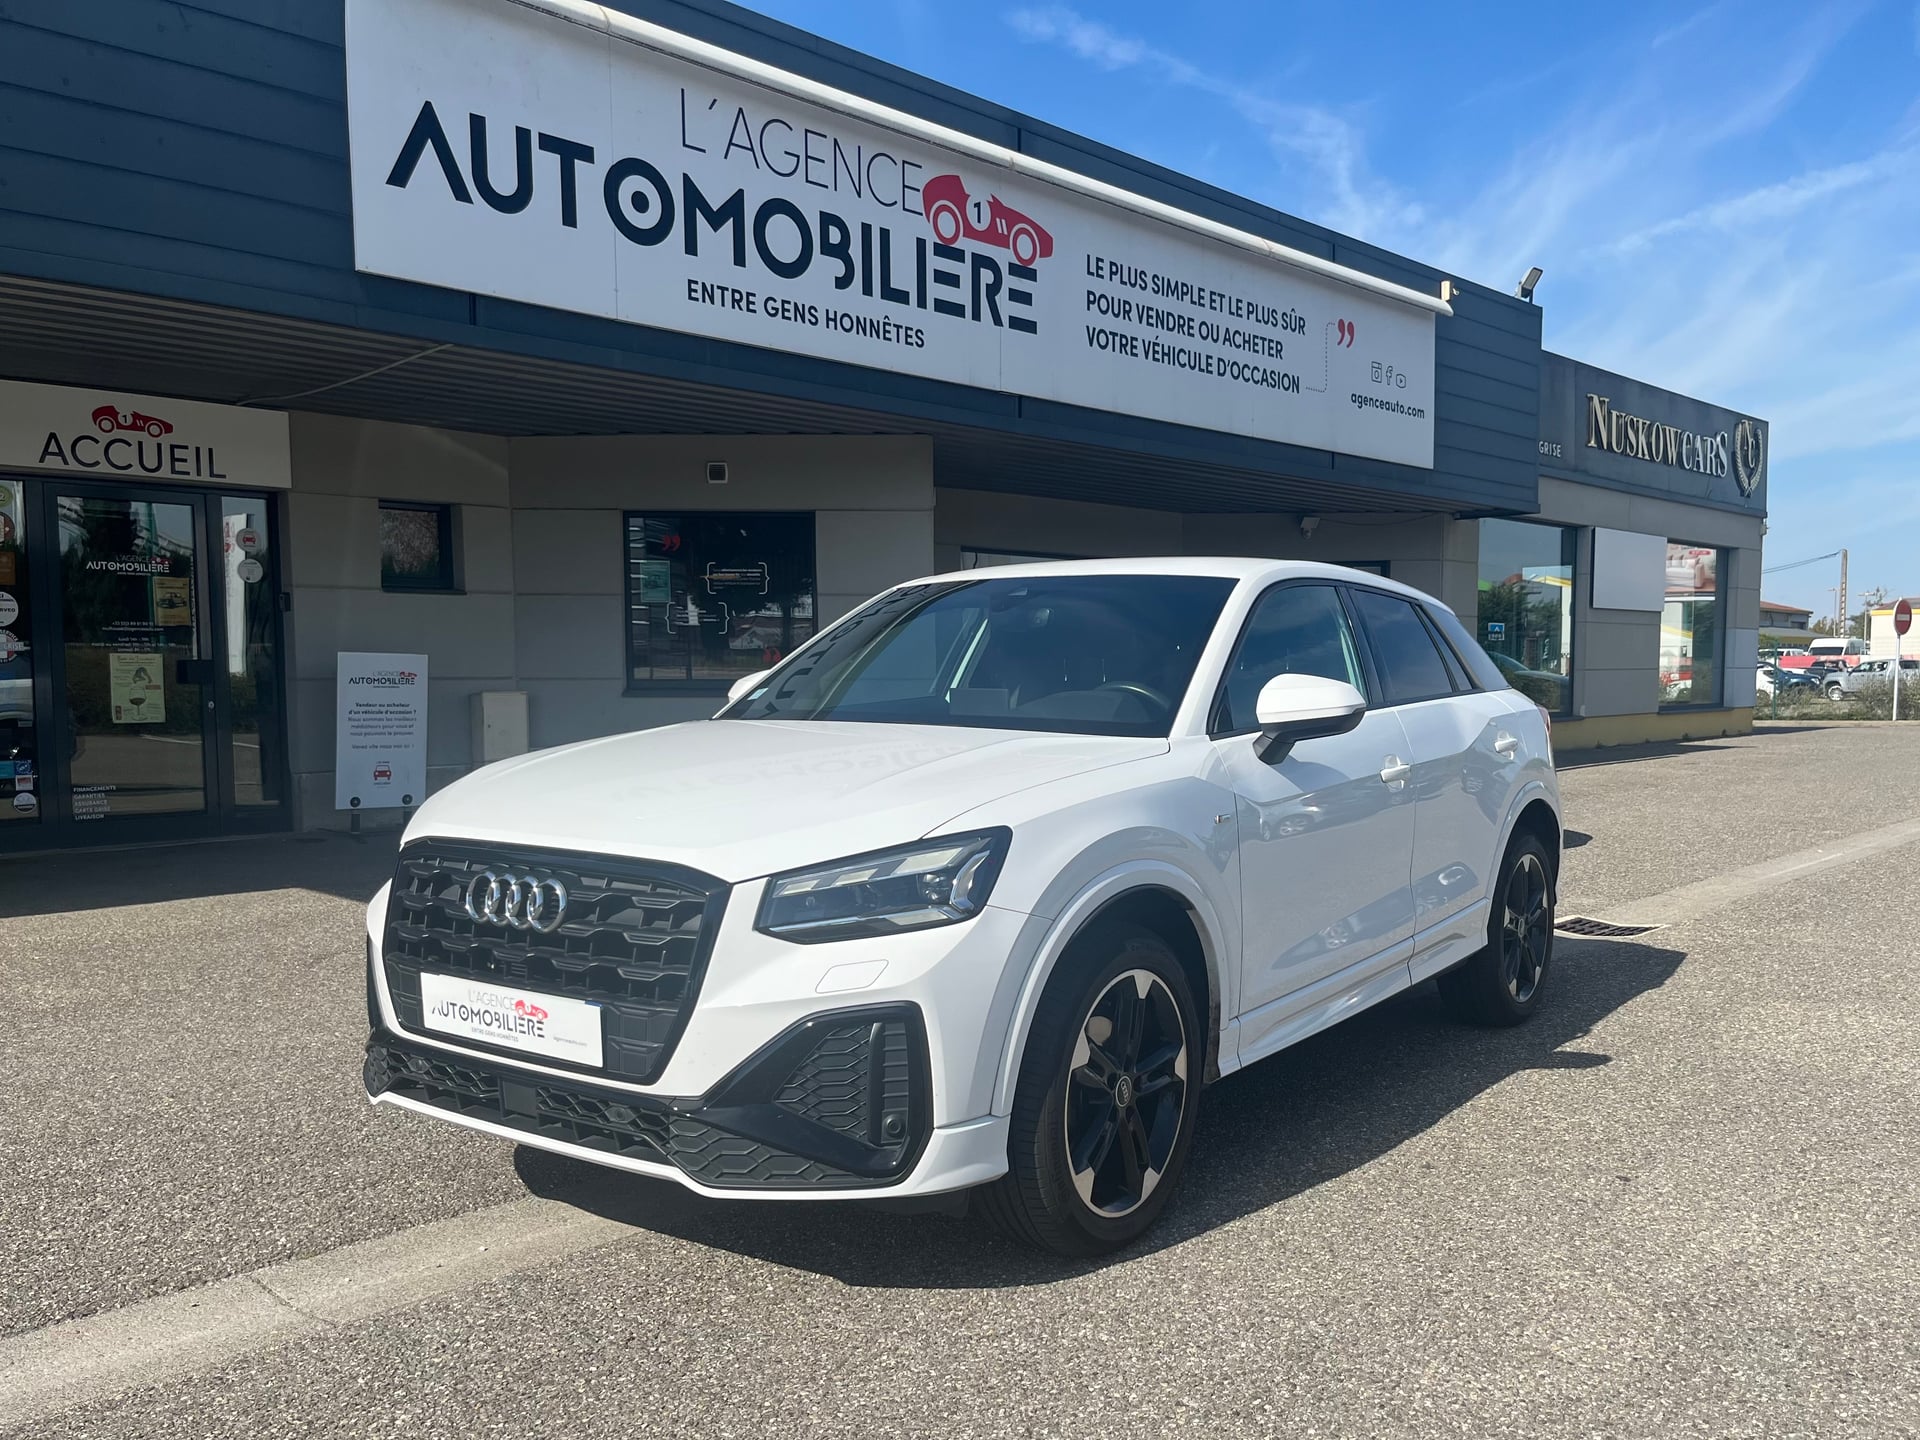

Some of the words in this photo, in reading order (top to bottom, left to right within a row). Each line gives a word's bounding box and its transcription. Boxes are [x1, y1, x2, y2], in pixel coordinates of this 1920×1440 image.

[681, 88, 925, 216] L'AGENCE
[687, 279, 757, 314] ENTRE
[763, 296, 819, 326] GENS
[825, 315, 925, 348] HONNÊTES
[1086, 254, 1105, 279] LE
[1109, 261, 1148, 291] PLUS
[1151, 274, 1205, 308] SIMPLE
[1209, 290, 1226, 313] ET
[1228, 296, 1243, 318] LE
[1247, 301, 1278, 328] PLUS
[1281, 308, 1306, 336] SÛR
[1086, 289, 1132, 322] POUR
[1136, 303, 1195, 338] VENDRE
[1199, 321, 1220, 344] OU
[1222, 327, 1284, 360] ACHETER
[1086, 325, 1139, 358] VOTRE
[1142, 335, 1213, 375] VÉHICULE
[1217, 357, 1300, 394] D'OCCASION
[1350, 393, 1425, 419] agenceauto.com
[38, 431, 227, 479] ACCUEIL
[467, 989, 515, 1011] L'AGENCE
